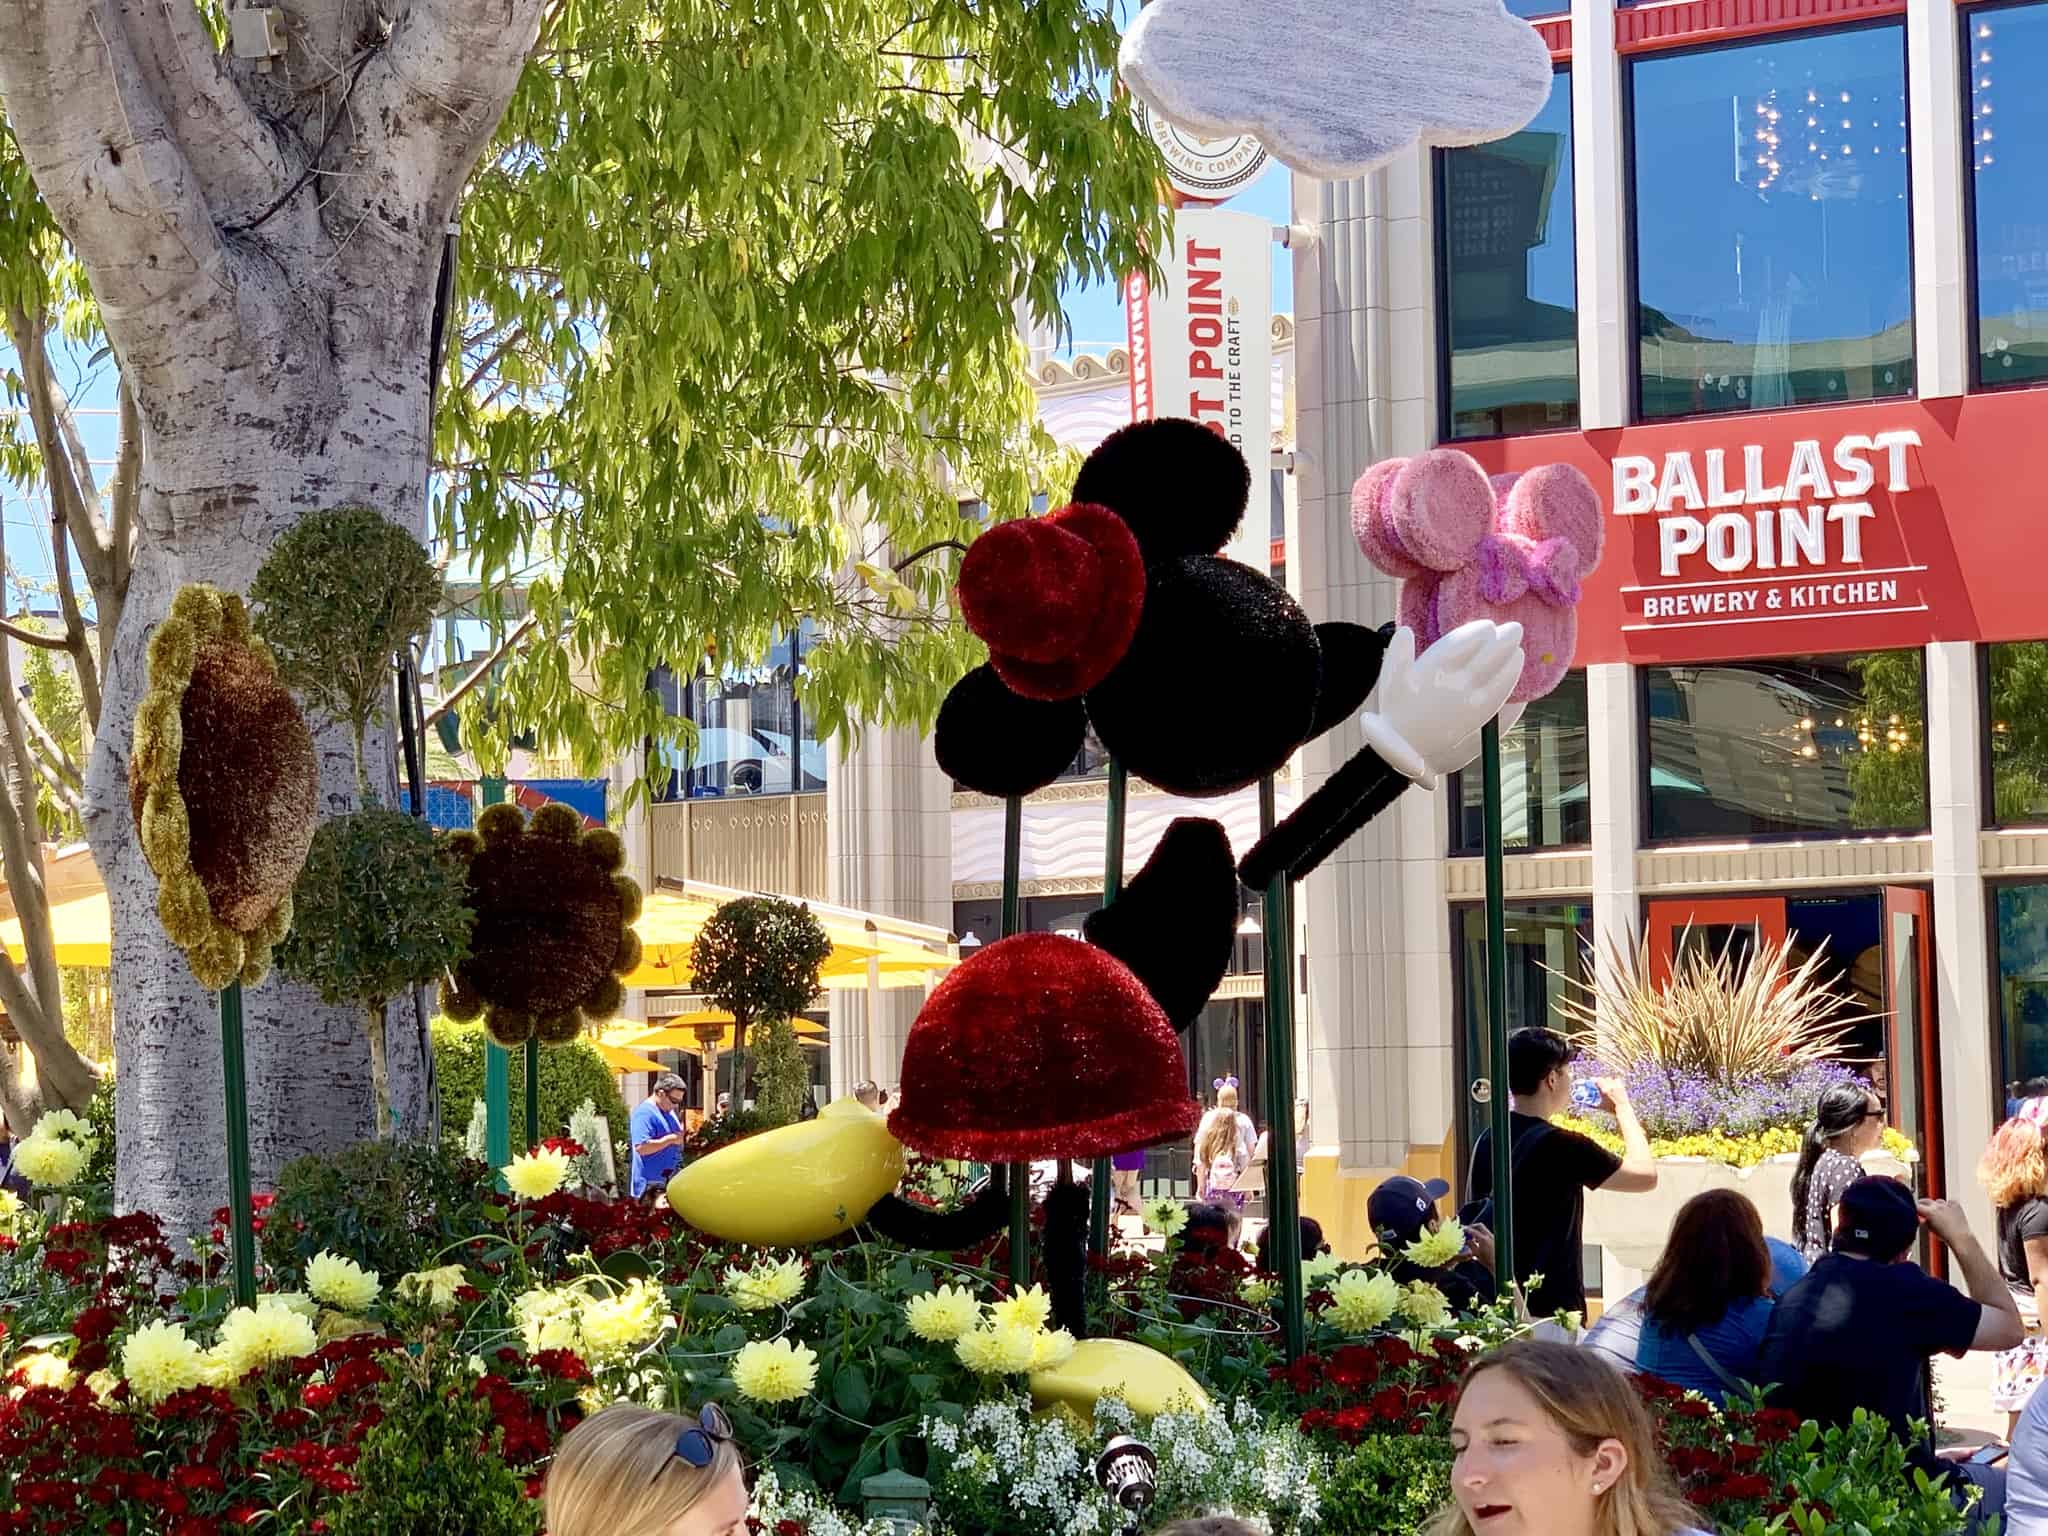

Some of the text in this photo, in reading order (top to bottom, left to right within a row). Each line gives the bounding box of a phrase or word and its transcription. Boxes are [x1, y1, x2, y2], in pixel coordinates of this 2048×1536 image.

[1153, 120, 1257, 173] BREWING COMPAN
[1187, 239, 1224, 379] POINT
[1227, 316, 1241, 367] CRAFT
[1228, 371, 1241, 402] THE
[1229, 407, 1242, 428] TO
[1611, 430, 1922, 516] BALLAST
[1658, 502, 1876, 577] POINT
[1643, 579, 1897, 618] BREWERY & KITCHEN
